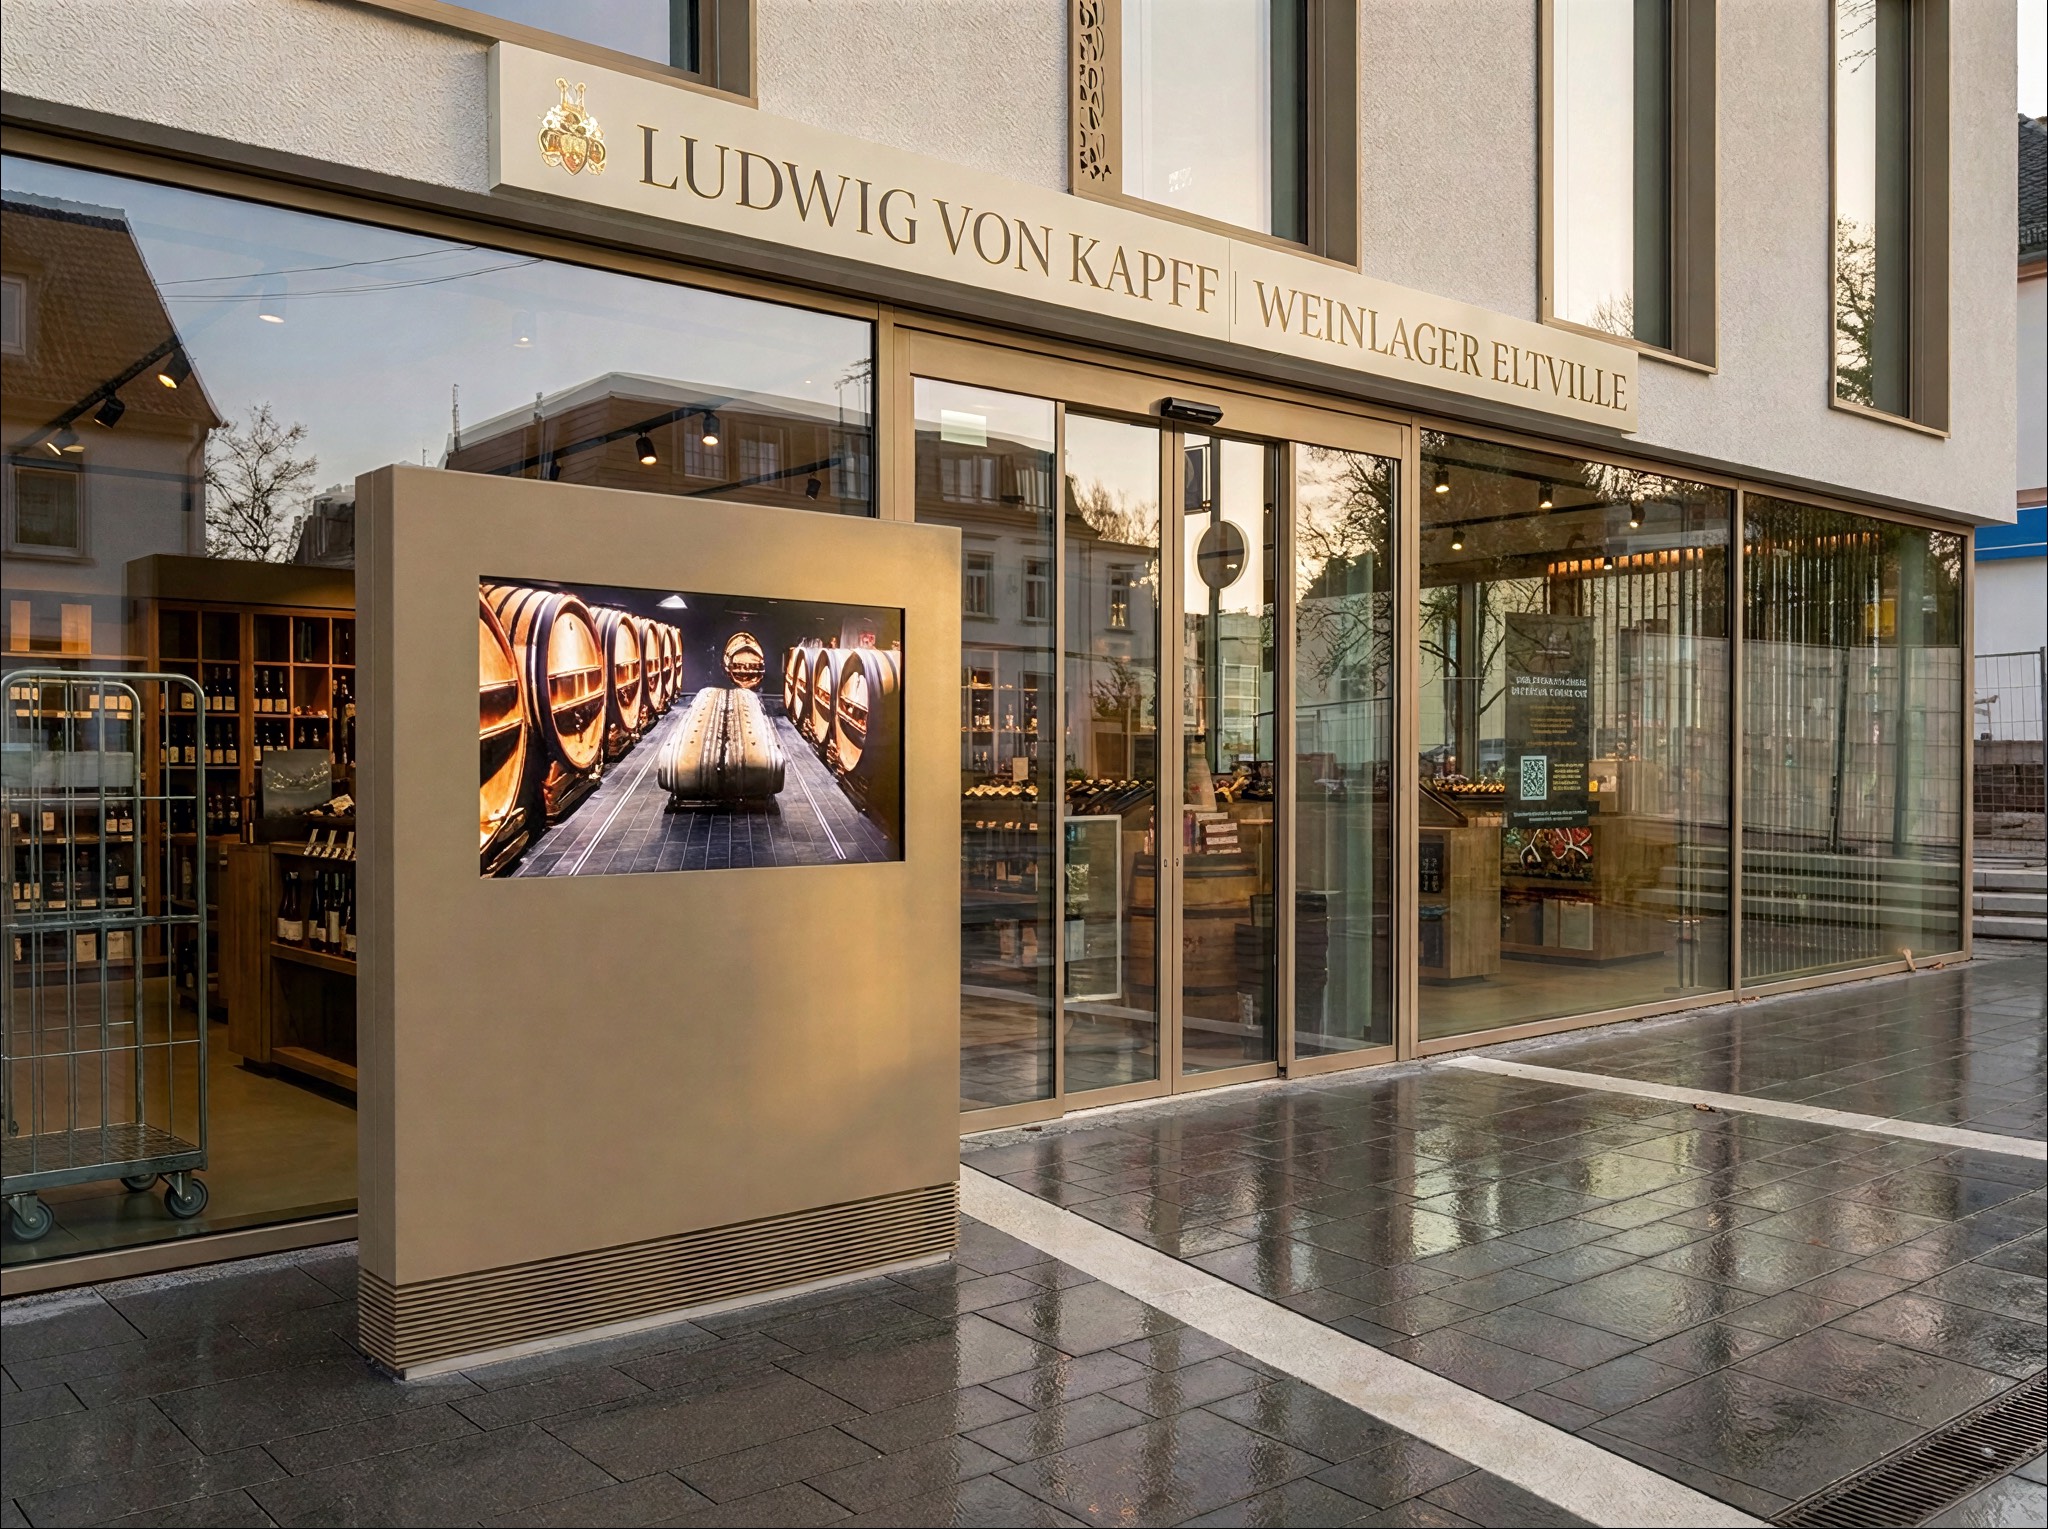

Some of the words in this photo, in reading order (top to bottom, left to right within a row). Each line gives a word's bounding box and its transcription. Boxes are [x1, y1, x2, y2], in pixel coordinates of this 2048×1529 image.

[637, 124, 918, 245] LUDWIG
[933, 198, 1052, 277] VON
[1069, 233, 1220, 314] KAPFF
[1253, 280, 1480, 377] WEINLAGER
[1491, 341, 1628, 412] ELTVILLE
